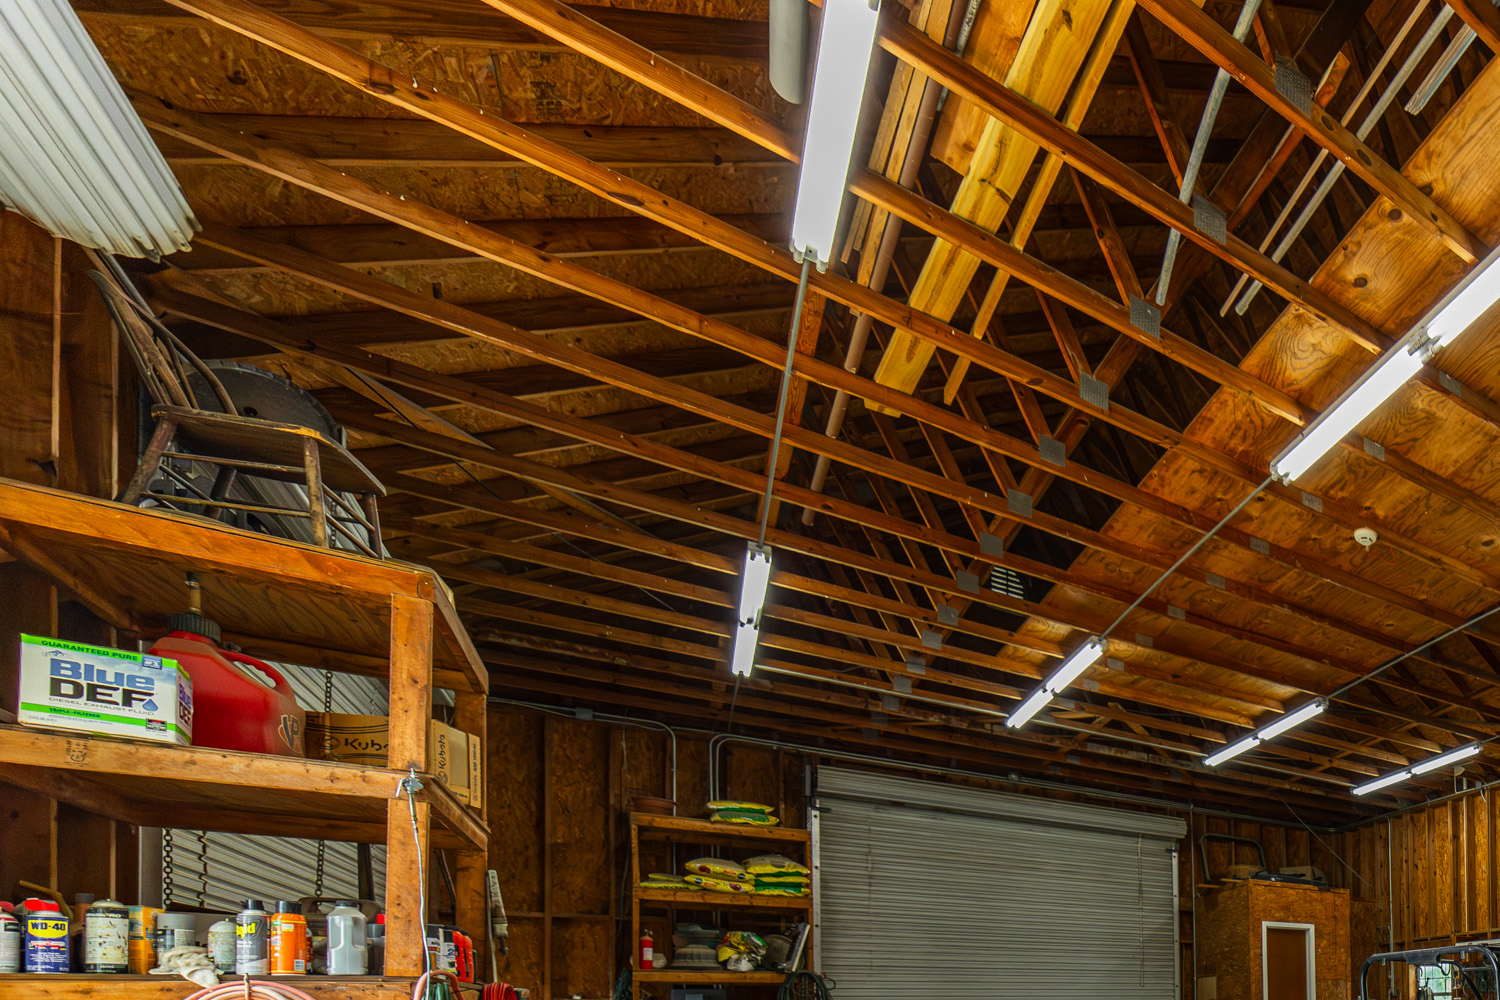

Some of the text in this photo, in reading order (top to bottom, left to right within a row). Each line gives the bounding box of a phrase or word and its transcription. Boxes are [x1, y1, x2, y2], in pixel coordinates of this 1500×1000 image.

[41, 640, 138, 661] GUARANTEED PURE
[50, 658, 154, 691] Blue
[49, 676, 154, 708] DEF
[48, 697, 155, 716] DIESEL EXHAUST FLUID
[49, 707, 101, 718] TRIPLE-FILTERED
[438, 734, 446, 770] Kubota
[30, 921, 66, 931] WD-40
